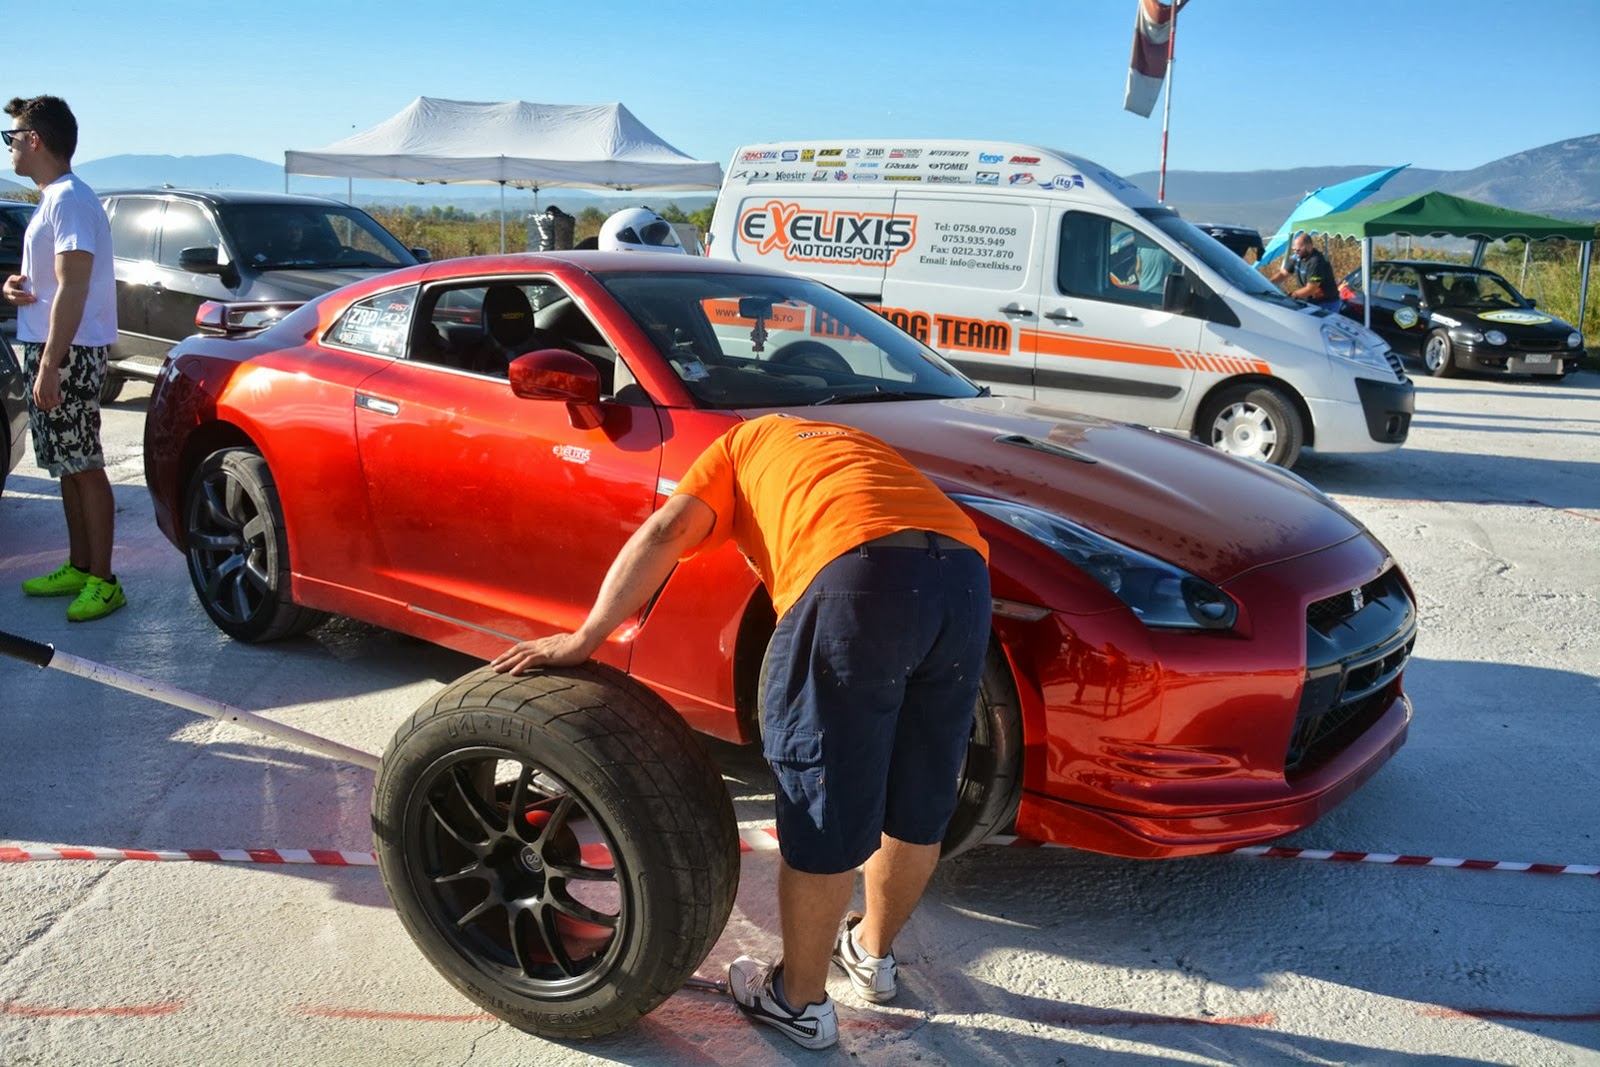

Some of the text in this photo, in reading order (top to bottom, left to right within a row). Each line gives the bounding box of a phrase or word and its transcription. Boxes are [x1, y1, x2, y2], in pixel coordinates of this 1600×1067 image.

[743, 151, 778, 160] AMSOIL
[979, 152, 1004, 164] Forge
[940, 163, 969, 171] TOMEI
[776, 171, 807, 181] Hoosier
[1055, 177, 1072, 189] itg
[744, 207, 911, 249] EXELIXIS
[934, 222, 1017, 236] Tel: 0758.970.058
[941, 234, 1006, 247] 0753.935.949
[789, 243, 895, 261] MOTORSPORT
[930, 244, 1014, 259] Fax: 0212.337.870
[919, 255, 1022, 272] Email: info@exelixis.ro
[348, 308, 379, 326] ZRP
[937, 317, 1008, 351] TEAM
[552, 445, 591, 460] EXELIXIS
